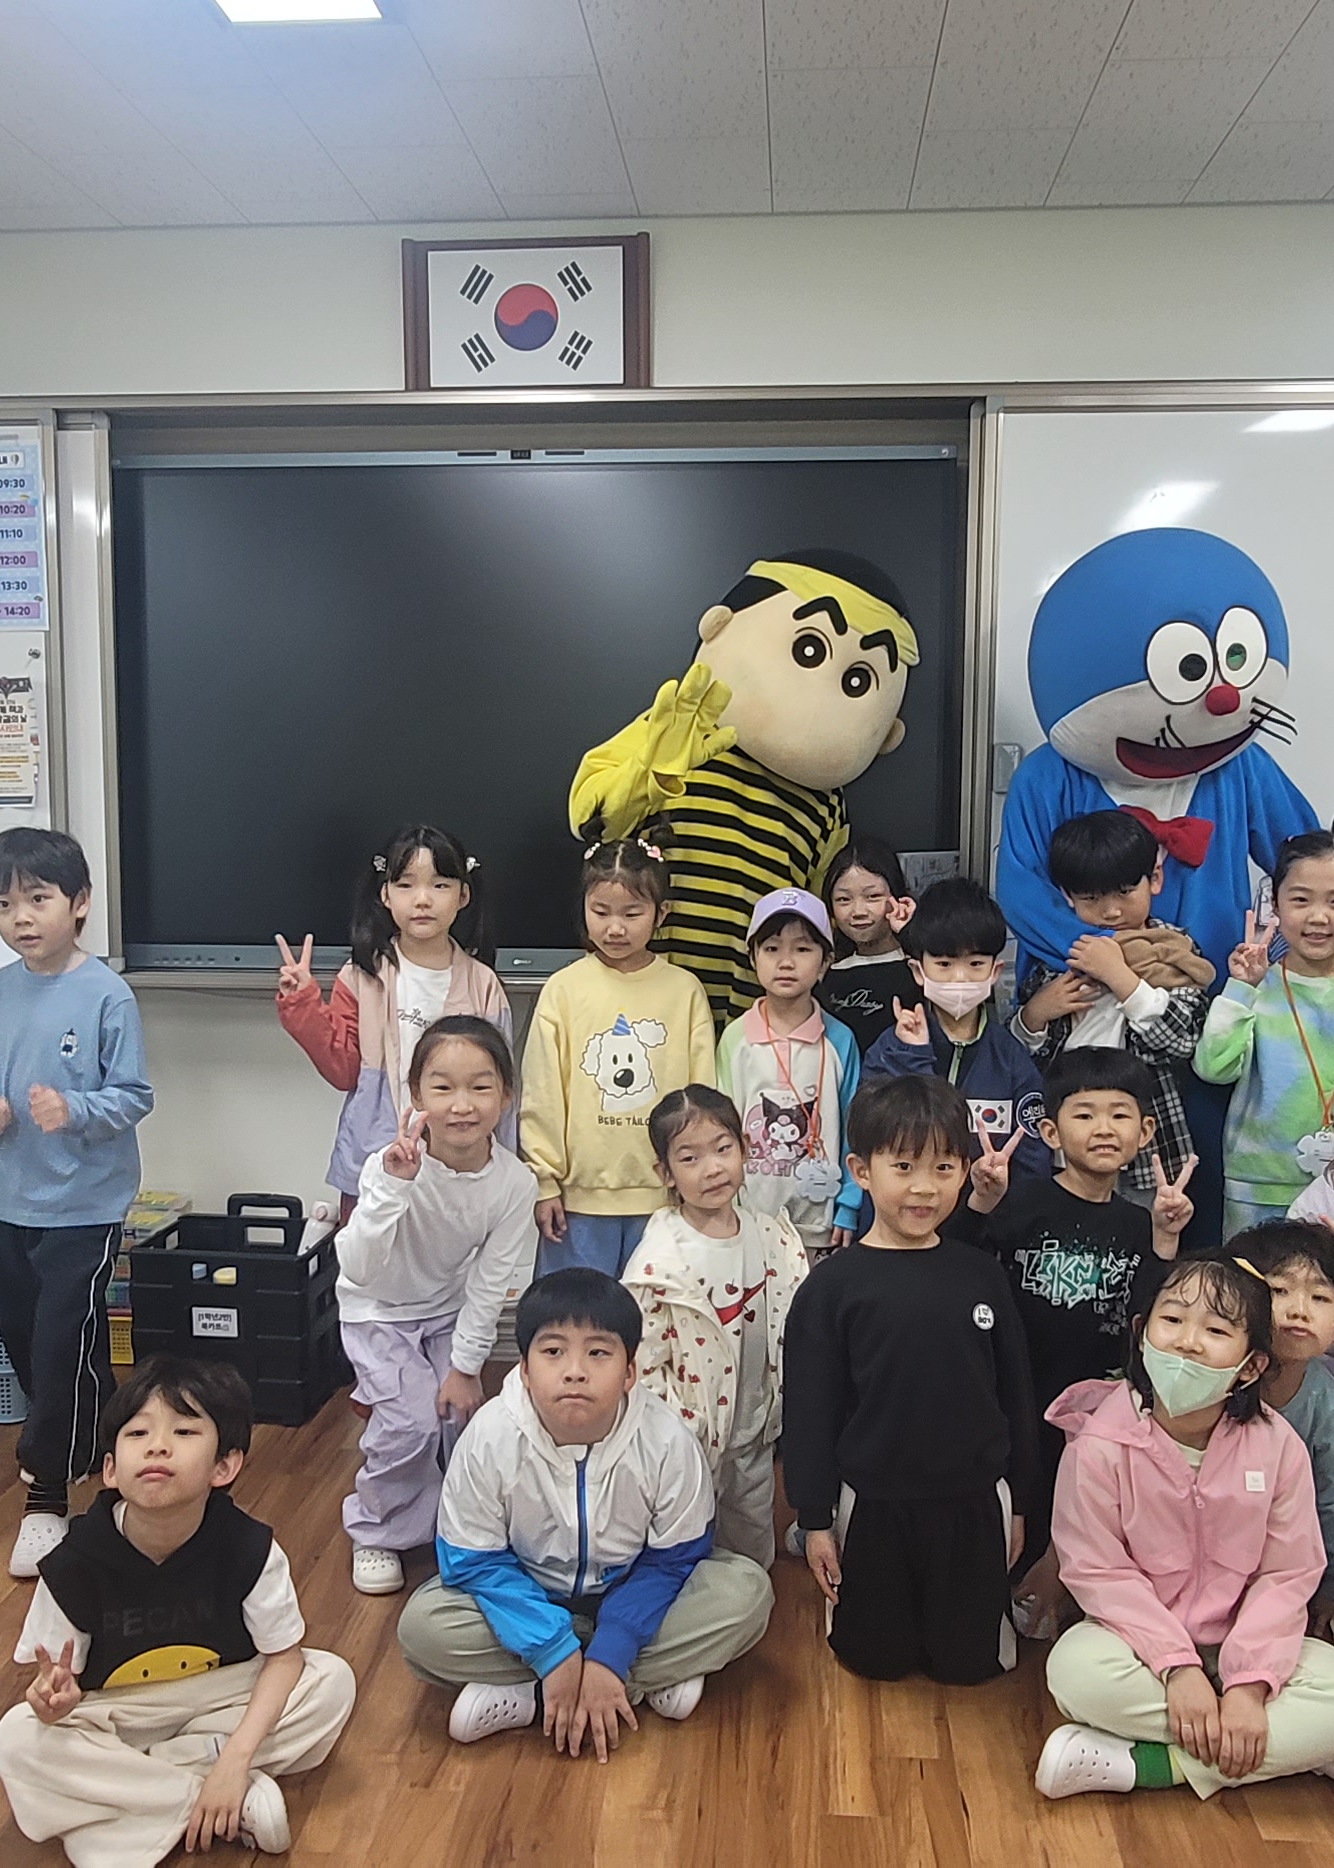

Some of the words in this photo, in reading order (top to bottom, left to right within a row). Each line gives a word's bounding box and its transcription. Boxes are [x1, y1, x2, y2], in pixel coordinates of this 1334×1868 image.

[0, 504, 26, 514] 10:20
[0, 528, 23, 539] 11:10
[0, 555, 26, 565] 12:00
[2, 580, 27, 590] 13:30
[4, 606, 31, 616] 14:20
[597, 1115, 622, 1126] BEBE
[625, 1115, 651, 1126] TAILO
